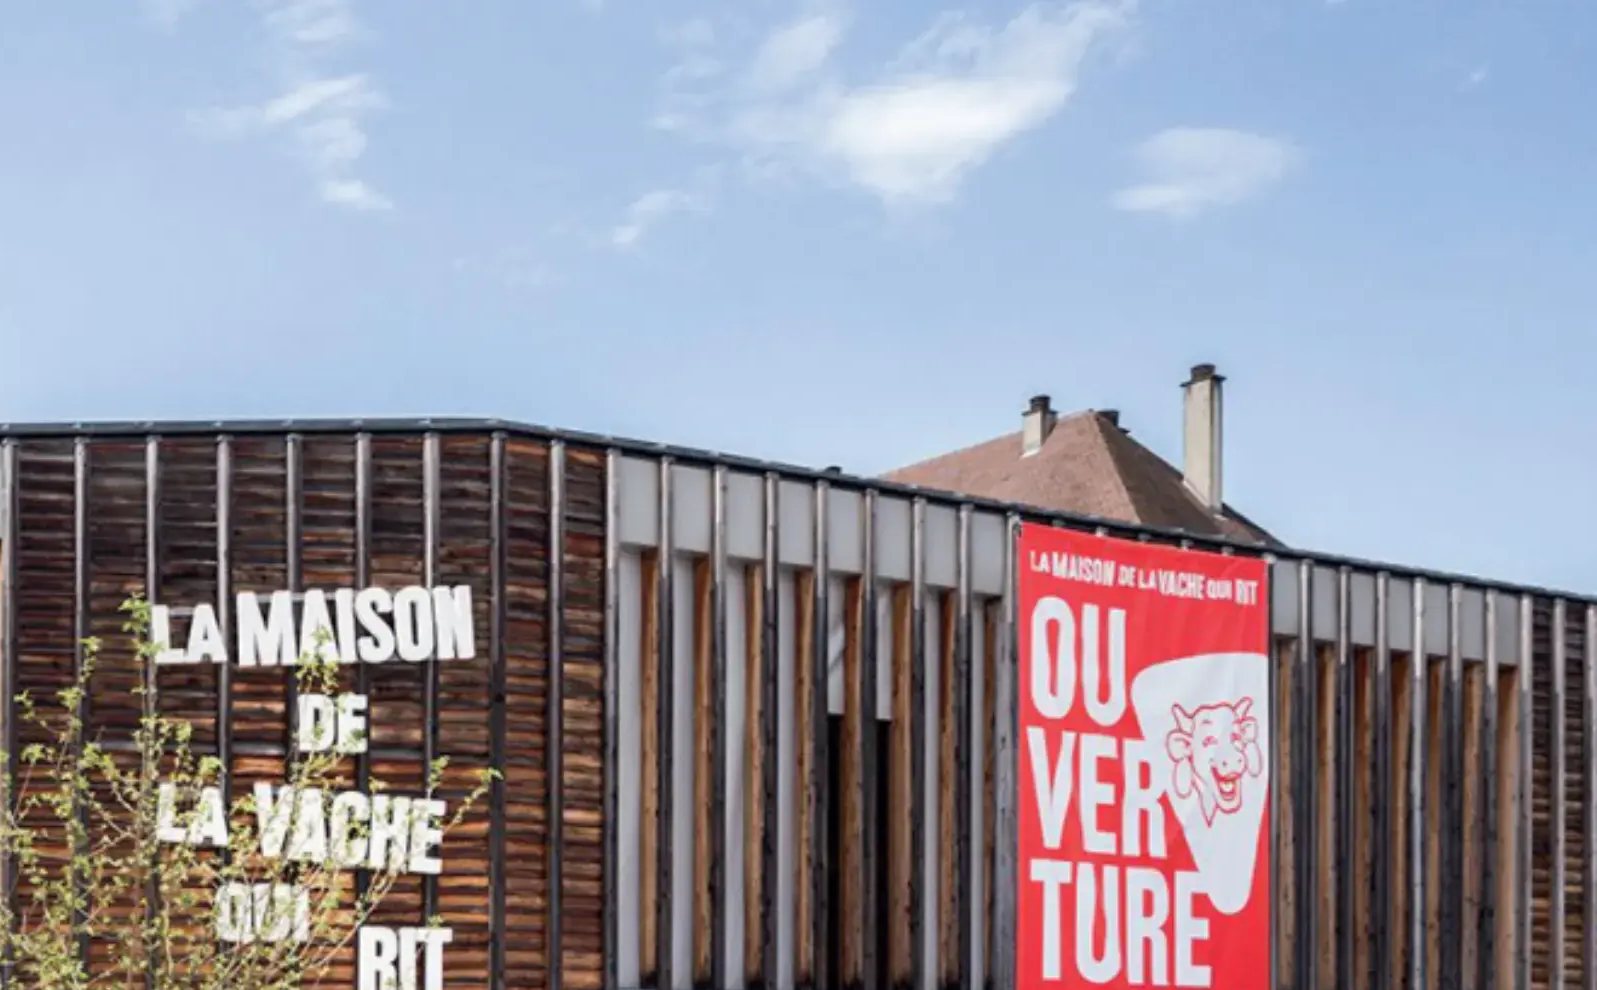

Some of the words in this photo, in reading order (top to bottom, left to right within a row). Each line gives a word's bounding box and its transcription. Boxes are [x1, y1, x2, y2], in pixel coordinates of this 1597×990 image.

[1029, 550, 1050, 573] LA
[1052, 551, 1115, 587] MAISON
[1118, 565, 1136, 588] DE
[1138, 568, 1156, 590] LA
[1158, 569, 1204, 599] VACHE
[1207, 579, 1232, 599] QUI
[152, 604, 227, 664] LA
[236, 585, 475, 666] MAISON
[1030, 596, 1126, 726] OU
[297, 693, 368, 753] DE
[156, 782, 228, 847] LA
[253, 781, 447, 874] VACHE
[1026, 727, 1167, 859] VER
[1029, 859, 1212, 988] TURE
